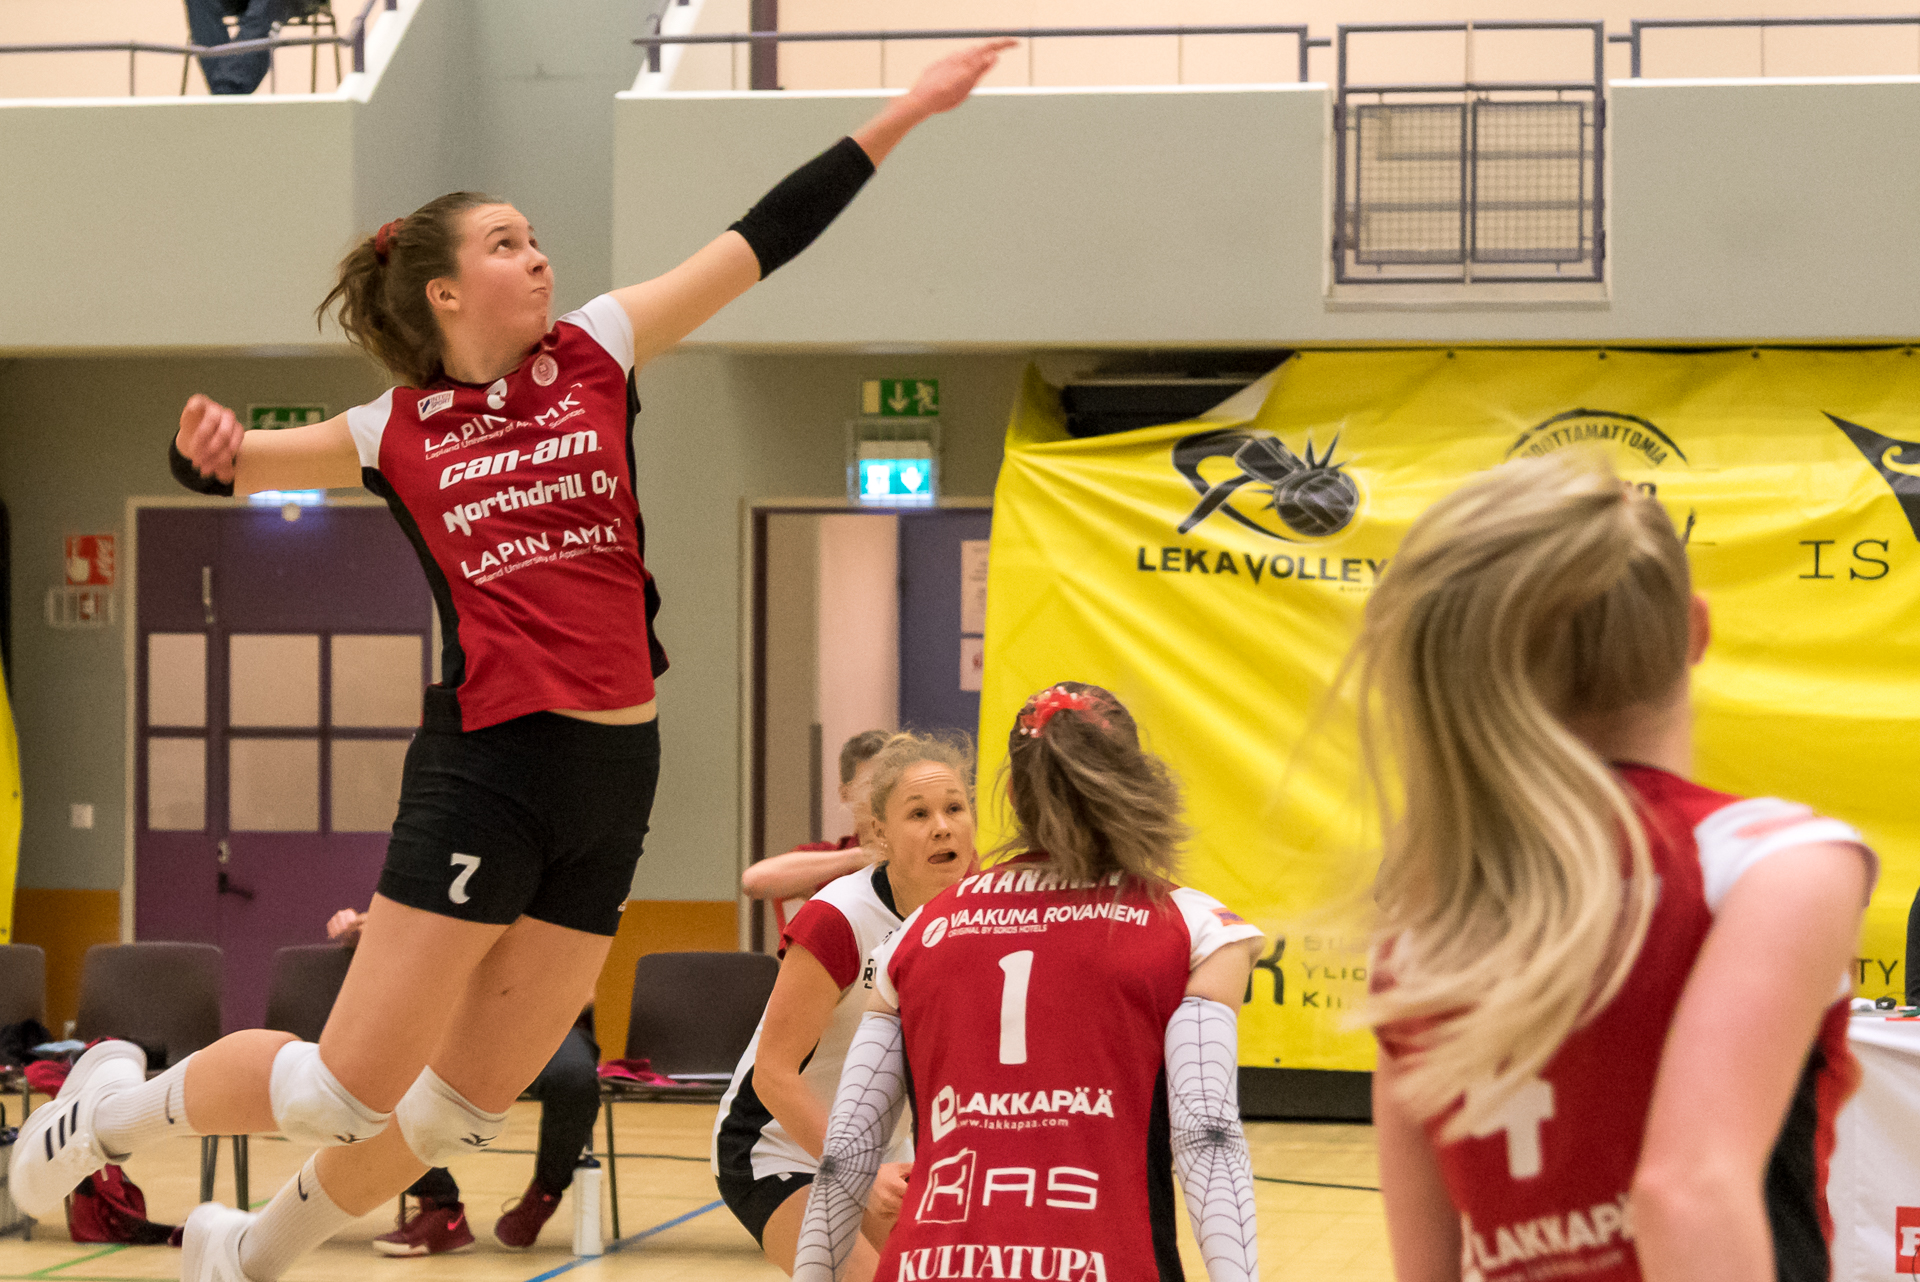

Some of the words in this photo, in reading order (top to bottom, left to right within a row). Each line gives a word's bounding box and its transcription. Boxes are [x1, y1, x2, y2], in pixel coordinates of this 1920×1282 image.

[425, 414, 507, 452] LAPIN
[534, 392, 581, 426] MK
[439, 430, 598, 490] can-am
[442, 473, 586, 537] Northdrill
[591, 470, 618, 500] Oy
[460, 531, 550, 579] LAPIN
[561, 524, 618, 548] AMK
[1799, 538, 1890, 581] IS
[449, 852, 482, 904] 7
[948, 926, 980, 938] ORIGINAL
[981, 926, 992, 935] BY
[993, 925, 1018, 935] SOKOS
[1018, 923, 1047, 934] HOTELS
[950, 908, 1038, 928] VAAKUNA
[1043, 903, 1150, 926] ROVANIEMI
[1302, 962, 1368, 982] YLIO
[998, 949, 1034, 1065] 1
[956, 1086, 1115, 1119] LAKKAPÄÄ
[897, 1244, 1108, 1282] KULTATUPA
